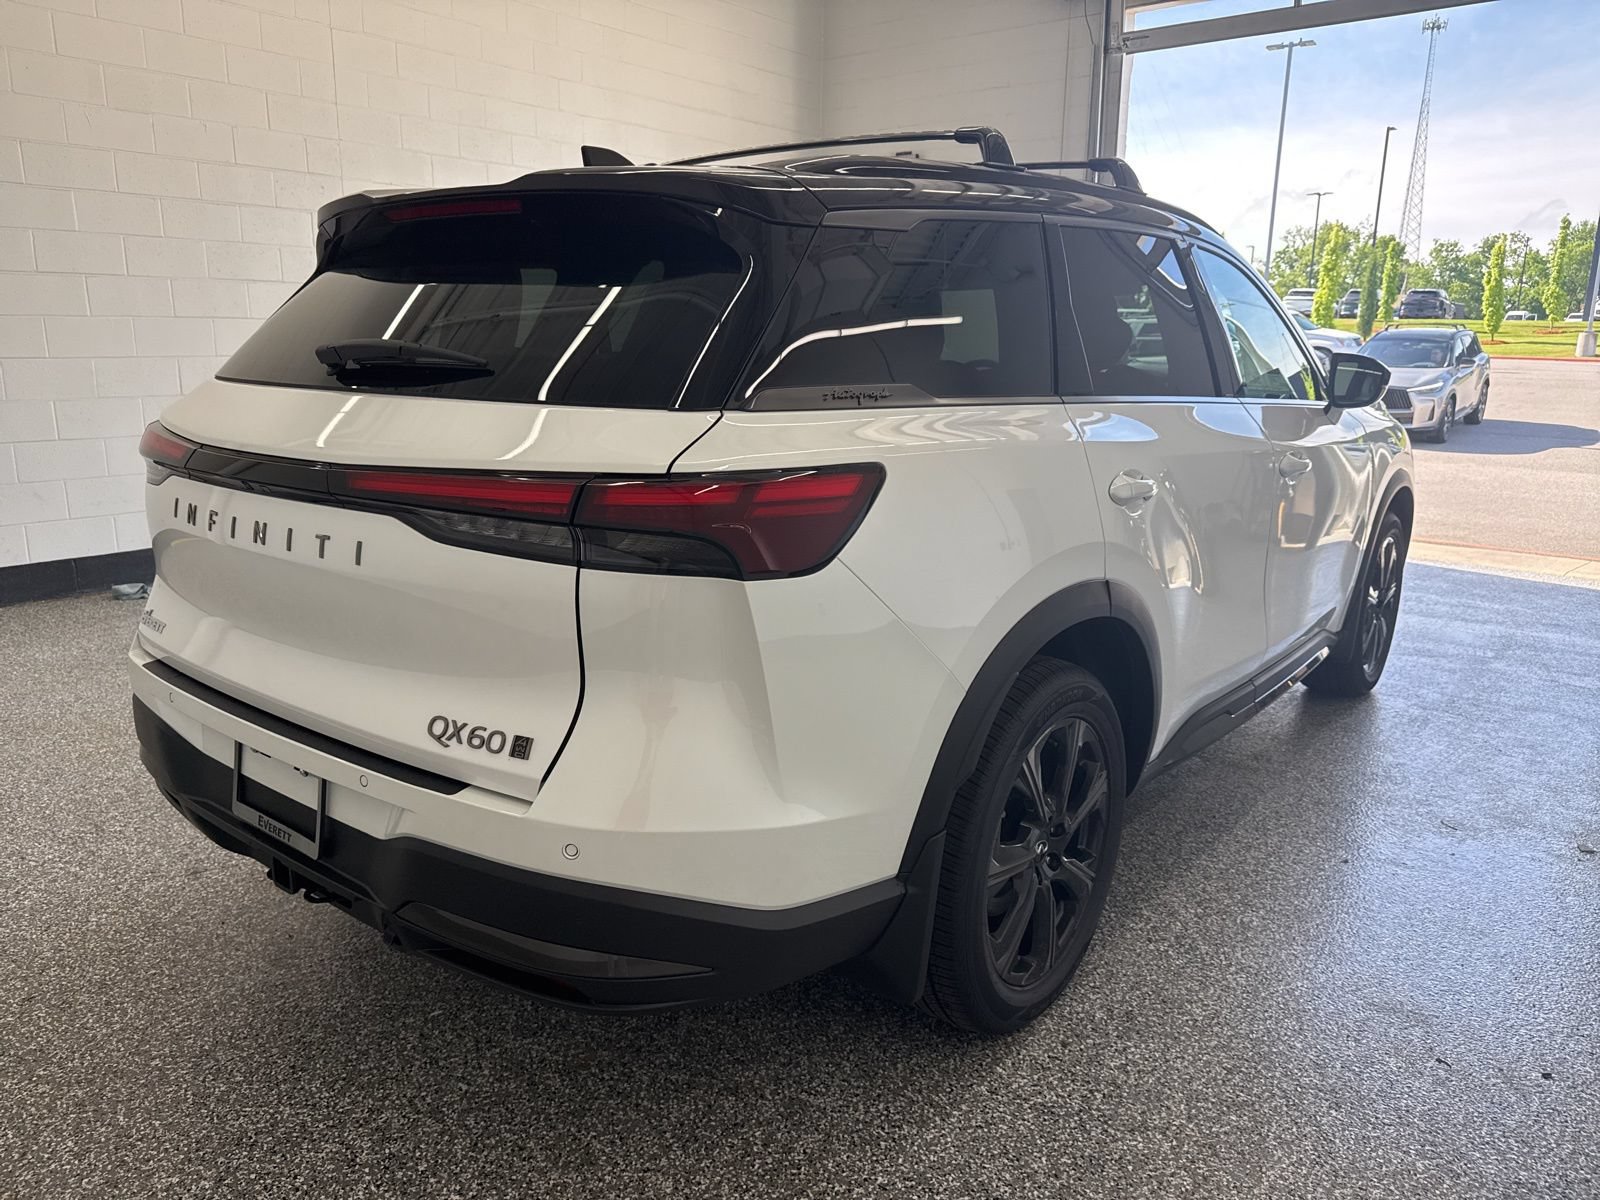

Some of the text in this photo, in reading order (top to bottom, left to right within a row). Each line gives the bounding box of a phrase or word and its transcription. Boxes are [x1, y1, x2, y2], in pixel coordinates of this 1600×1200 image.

[174, 498, 362, 566] INFINITI
[427, 715, 506, 754] QX60
[257, 814, 292, 843] EVERETT
